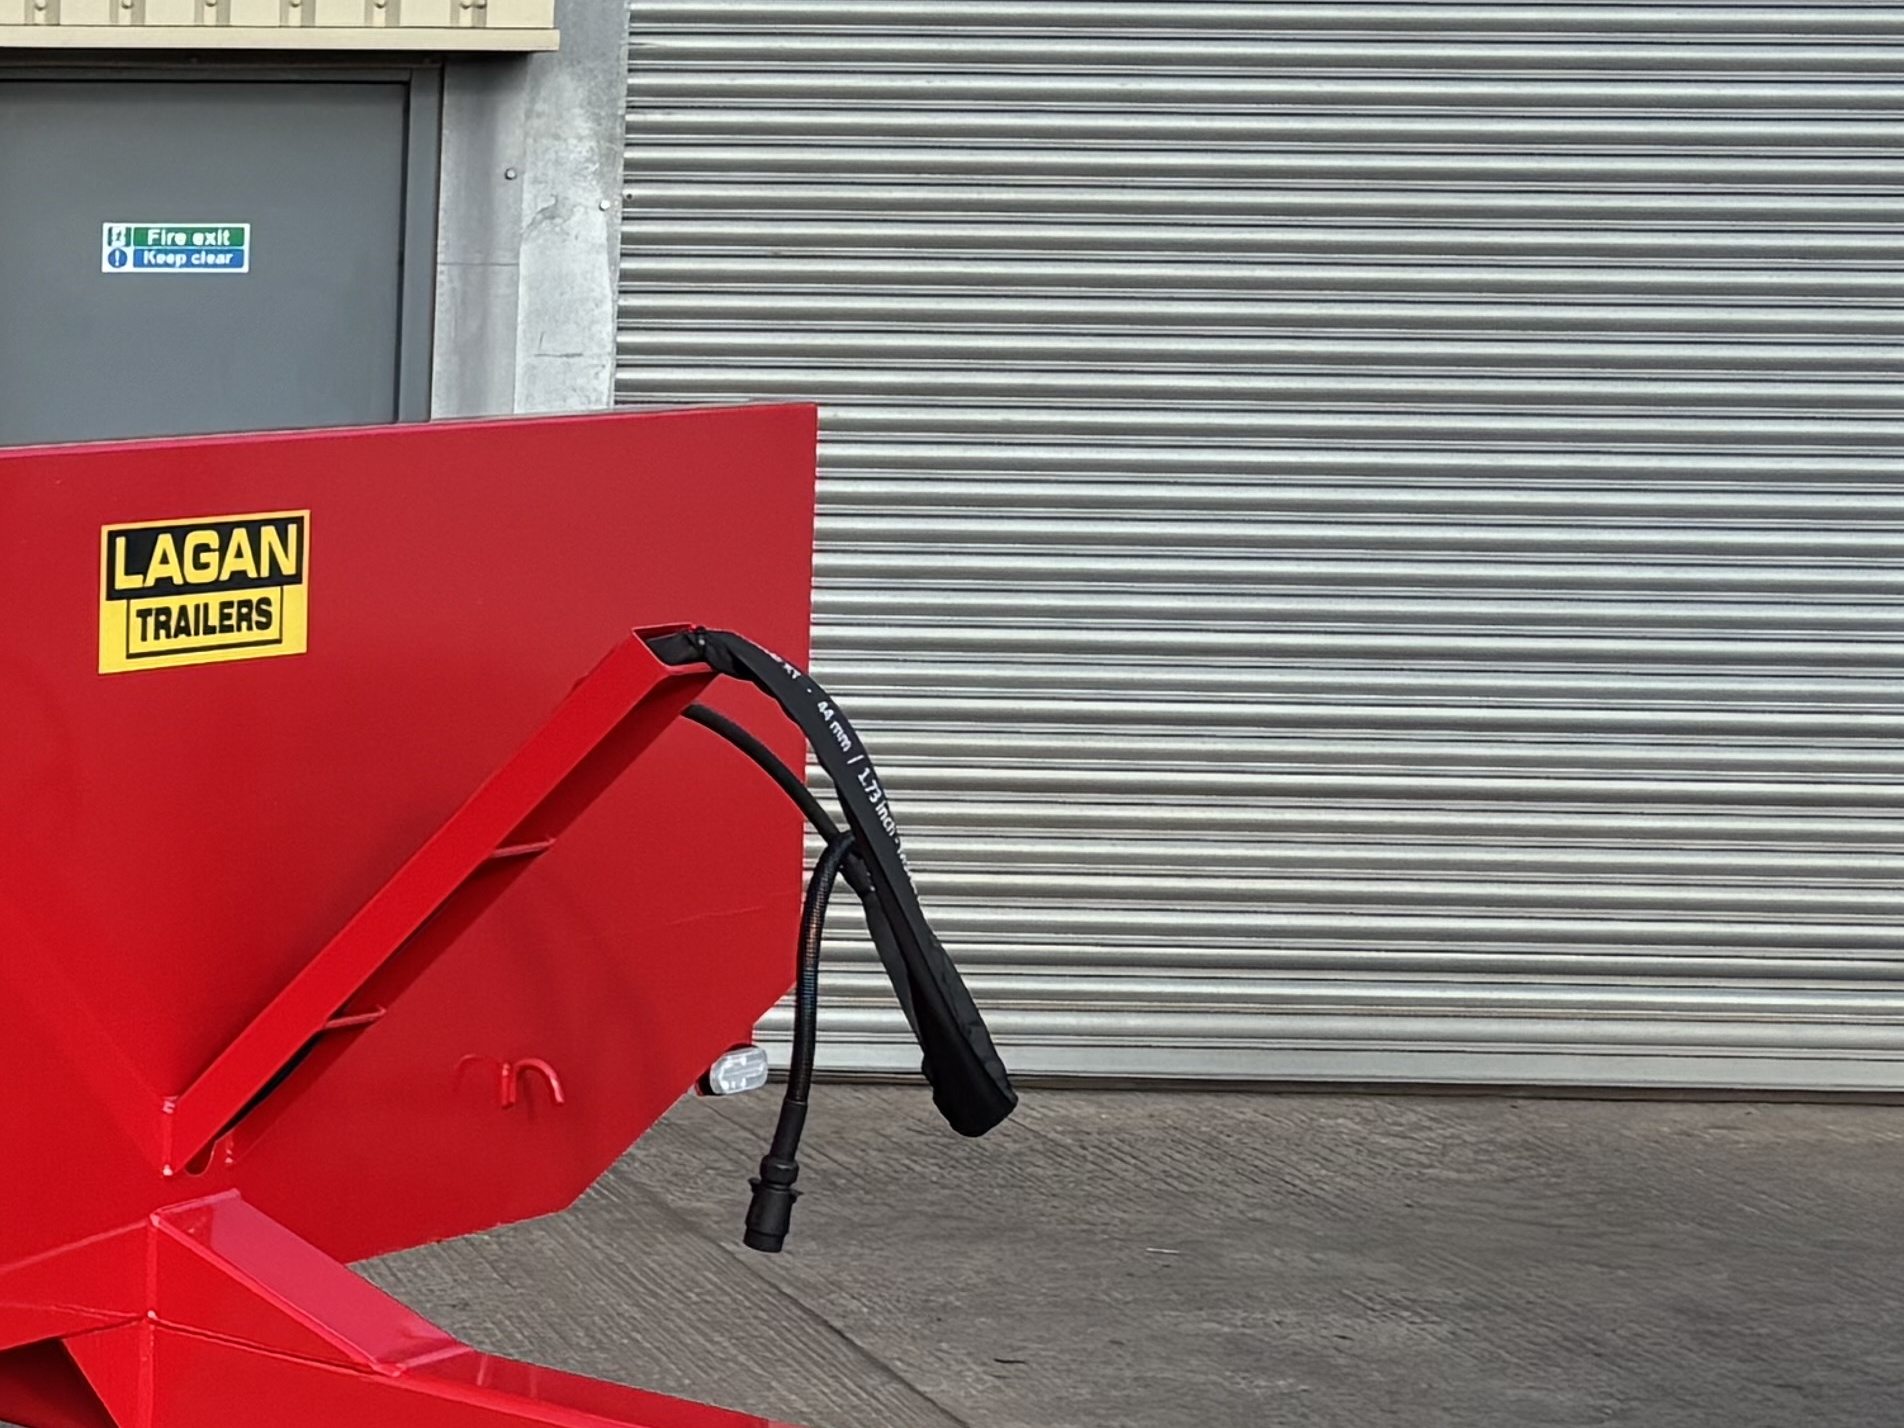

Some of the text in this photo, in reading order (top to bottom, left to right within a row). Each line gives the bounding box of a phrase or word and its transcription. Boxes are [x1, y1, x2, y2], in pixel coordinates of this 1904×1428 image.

[143, 250, 233, 268] Keep clear
[147, 228, 230, 246] Fire exit
[114, 523, 298, 590] LAGAN
[136, 597, 272, 642] TRAILERS
[817, 701, 834, 721] 44
[830, 721, 852, 752] mm
[857, 767, 882, 803] 1.73
[874, 799, 898, 837] inch
